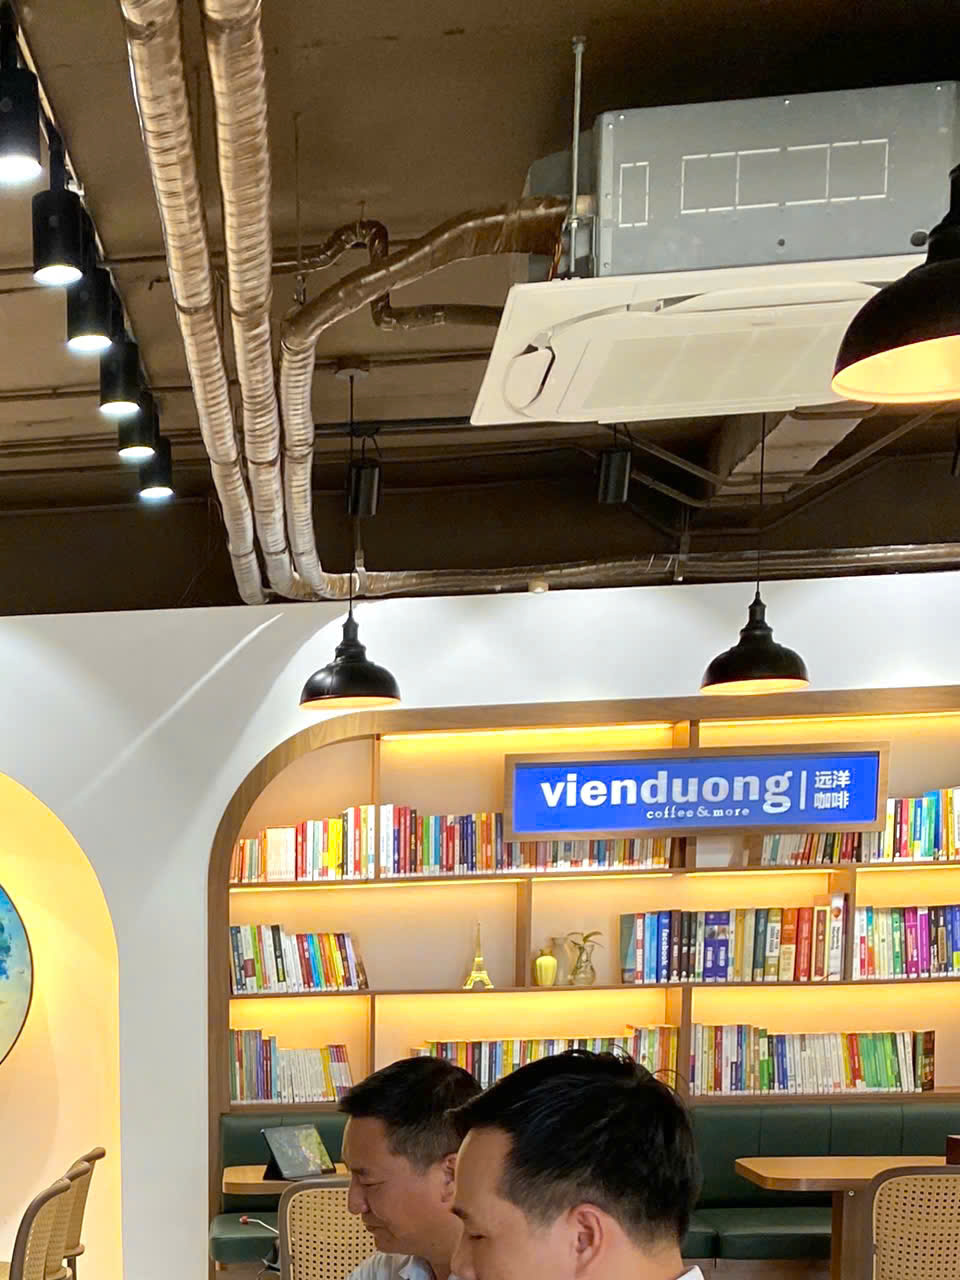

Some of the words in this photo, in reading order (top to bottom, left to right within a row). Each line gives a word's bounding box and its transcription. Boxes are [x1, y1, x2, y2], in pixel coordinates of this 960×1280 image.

[814, 769, 851, 788] 远洋
[540, 770, 793, 814] vienduong
[814, 790, 850, 809] 咖啡
